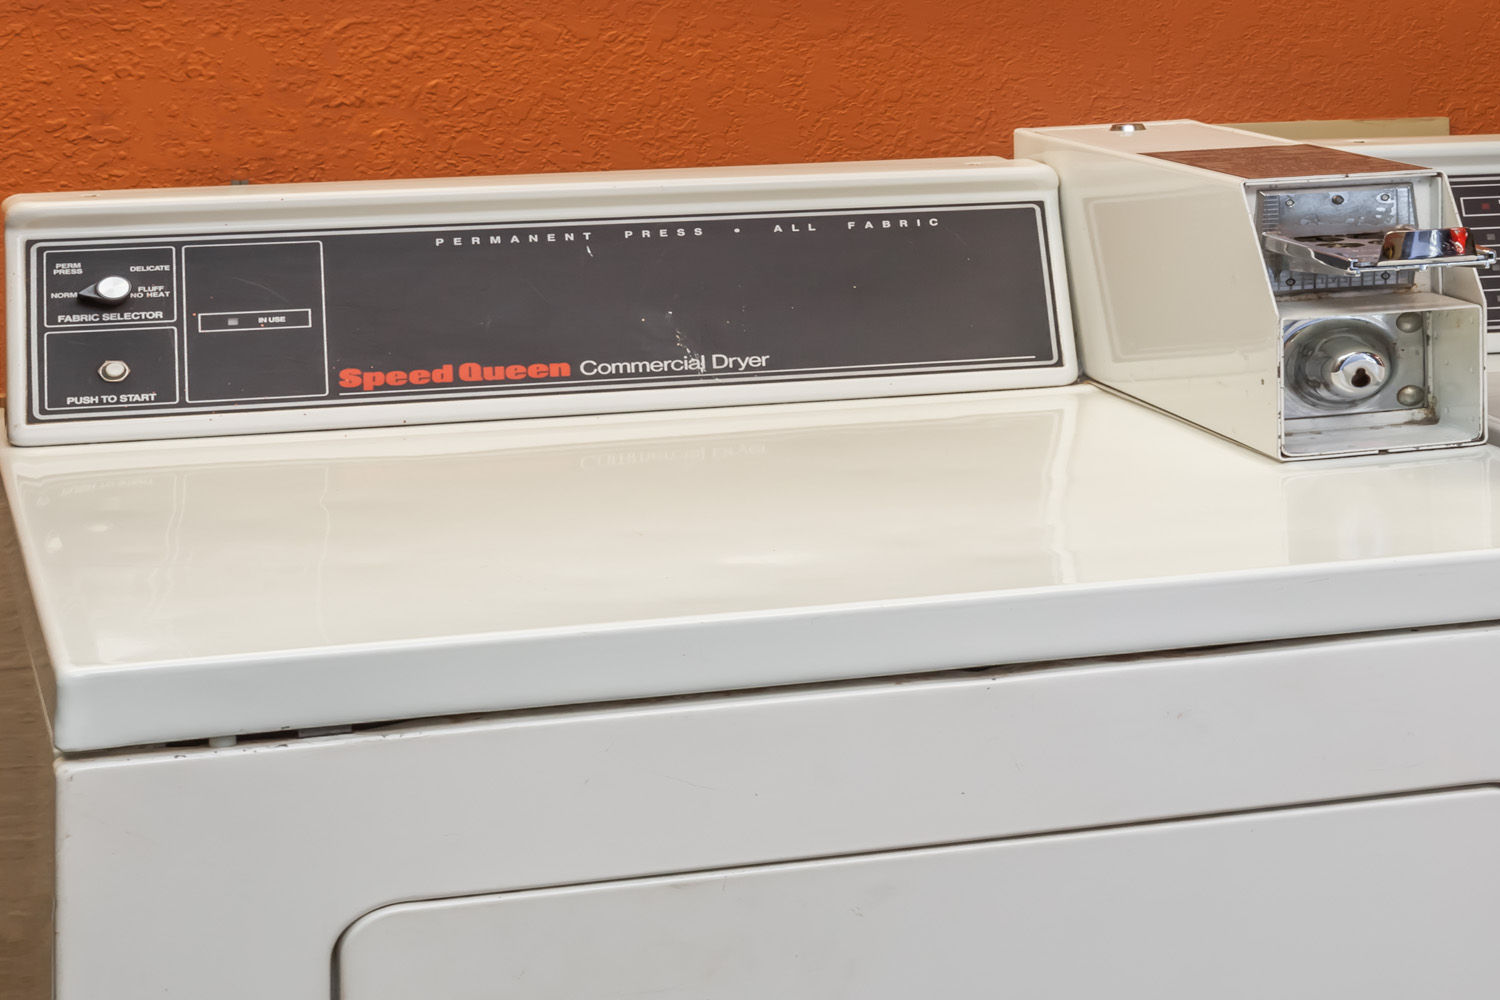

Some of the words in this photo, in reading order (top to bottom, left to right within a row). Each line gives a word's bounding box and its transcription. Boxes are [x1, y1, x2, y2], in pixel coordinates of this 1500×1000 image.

[435, 232, 592, 247] PERMANENT
[624, 227, 703, 239] PRESS
[774, 223, 816, 233] ALL
[847, 218, 939, 230] FABRIC
[130, 264, 170, 272] DELICATE
[51, 291, 78, 299] NORM
[147, 290, 170, 298] HEAT
[57, 314, 100, 323] FABRIC
[102, 311, 163, 321] SELECTOR
[258, 316, 267, 324] IN
[339, 364, 453, 391] Speed
[459, 361, 570, 382] Queen
[579, 354, 705, 376] Commercial
[712, 352, 770, 371] Dryer
[67, 396, 100, 405] PUSH
[101, 395, 117, 404] TO
[119, 393, 156, 403] START
